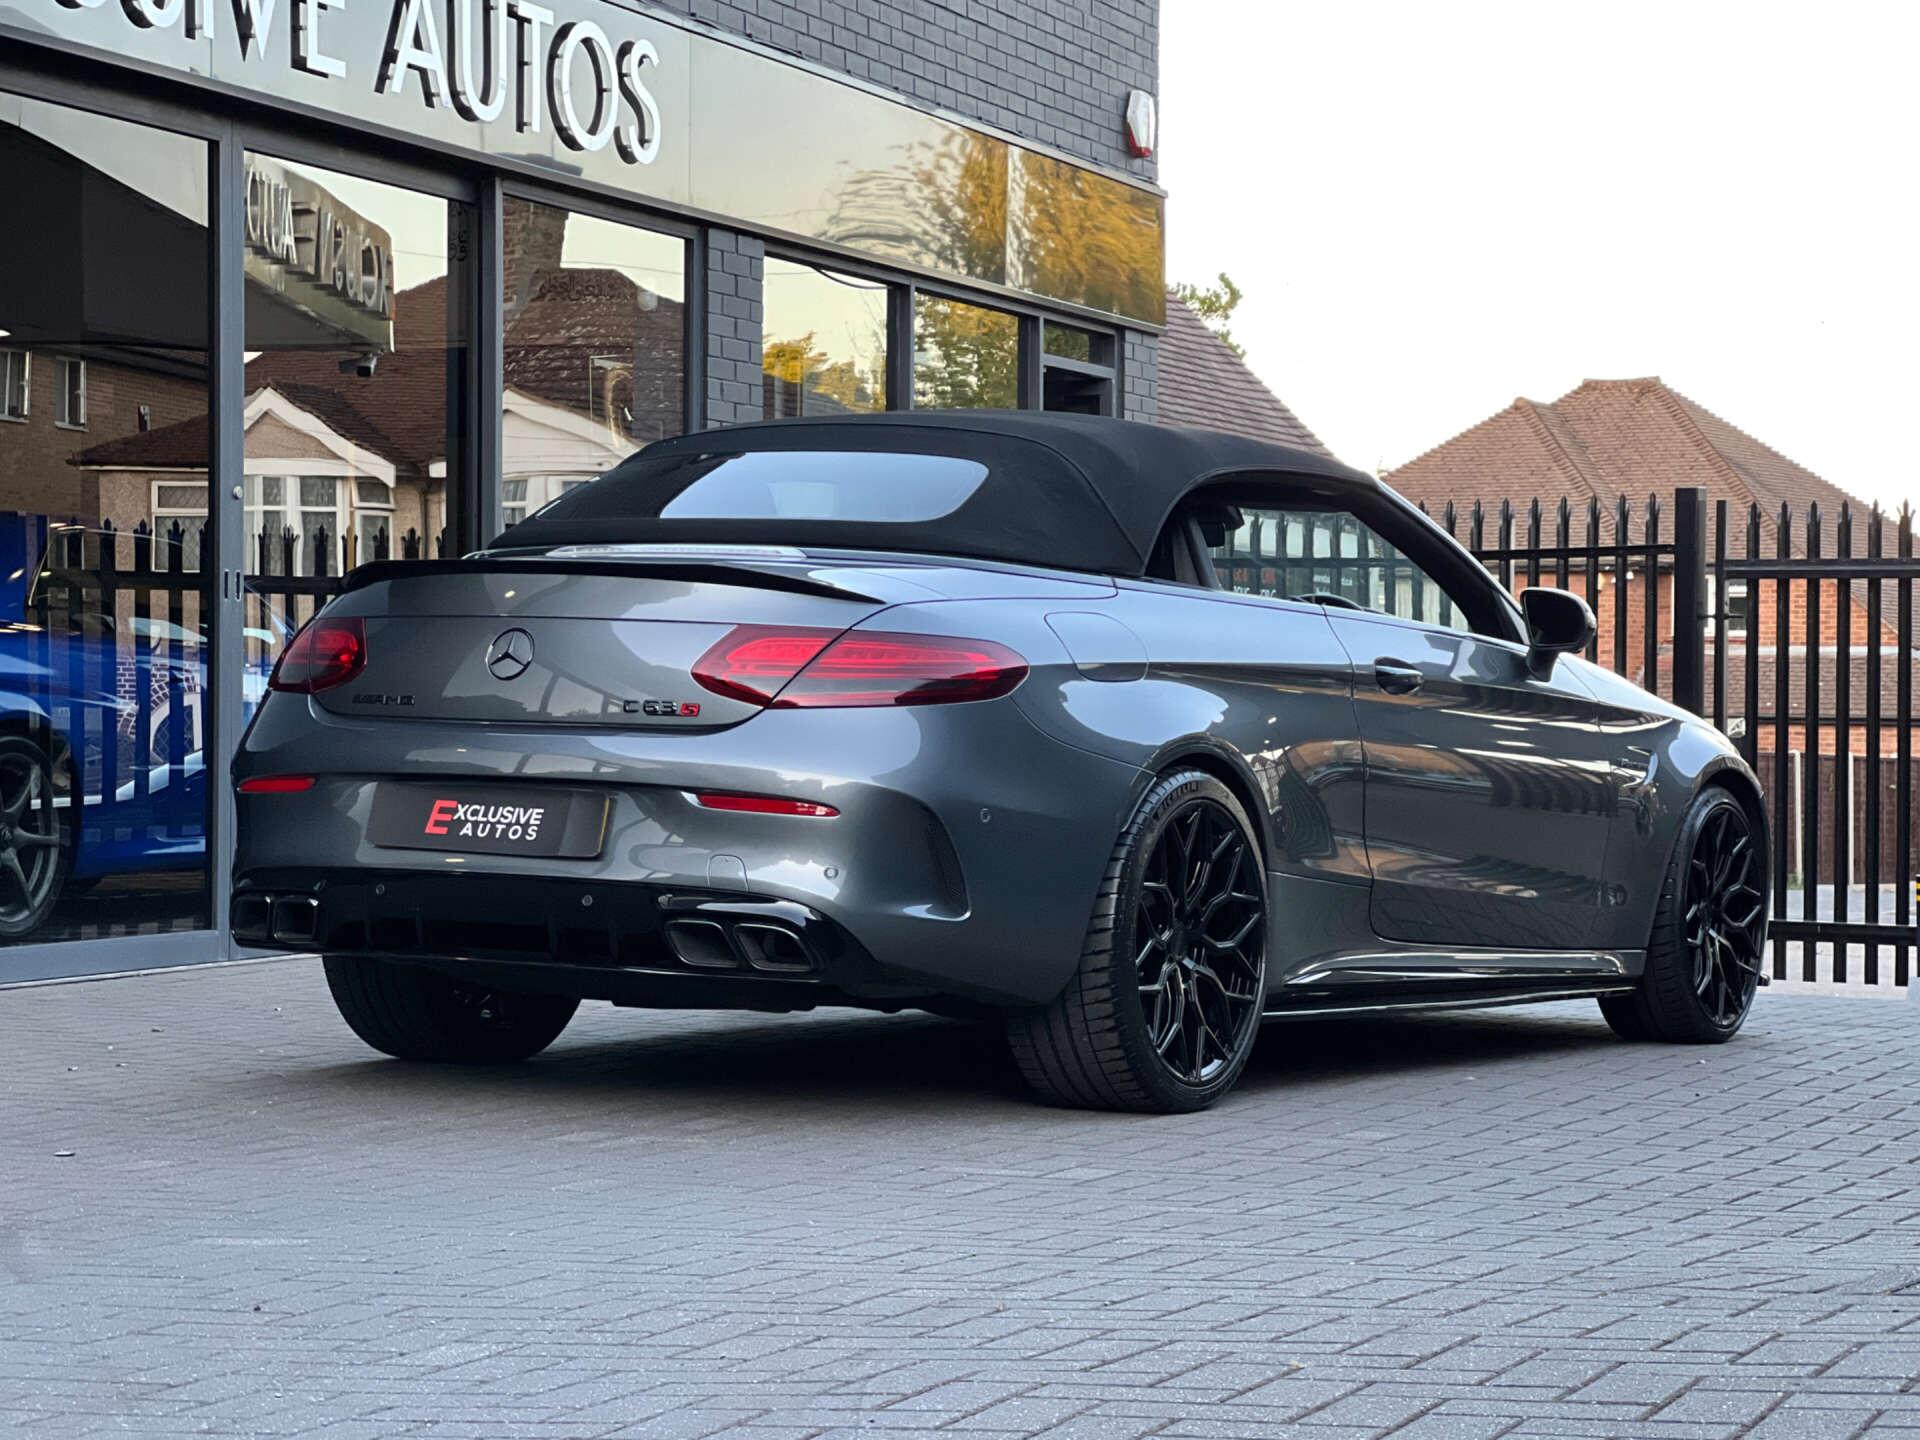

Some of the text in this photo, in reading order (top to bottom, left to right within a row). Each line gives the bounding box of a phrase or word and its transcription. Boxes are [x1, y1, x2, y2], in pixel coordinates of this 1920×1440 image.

[375, 0, 661, 165] AUTOS
[424, 800, 544, 835] EXCLUSIVE
[460, 822, 538, 840] AUTOS
